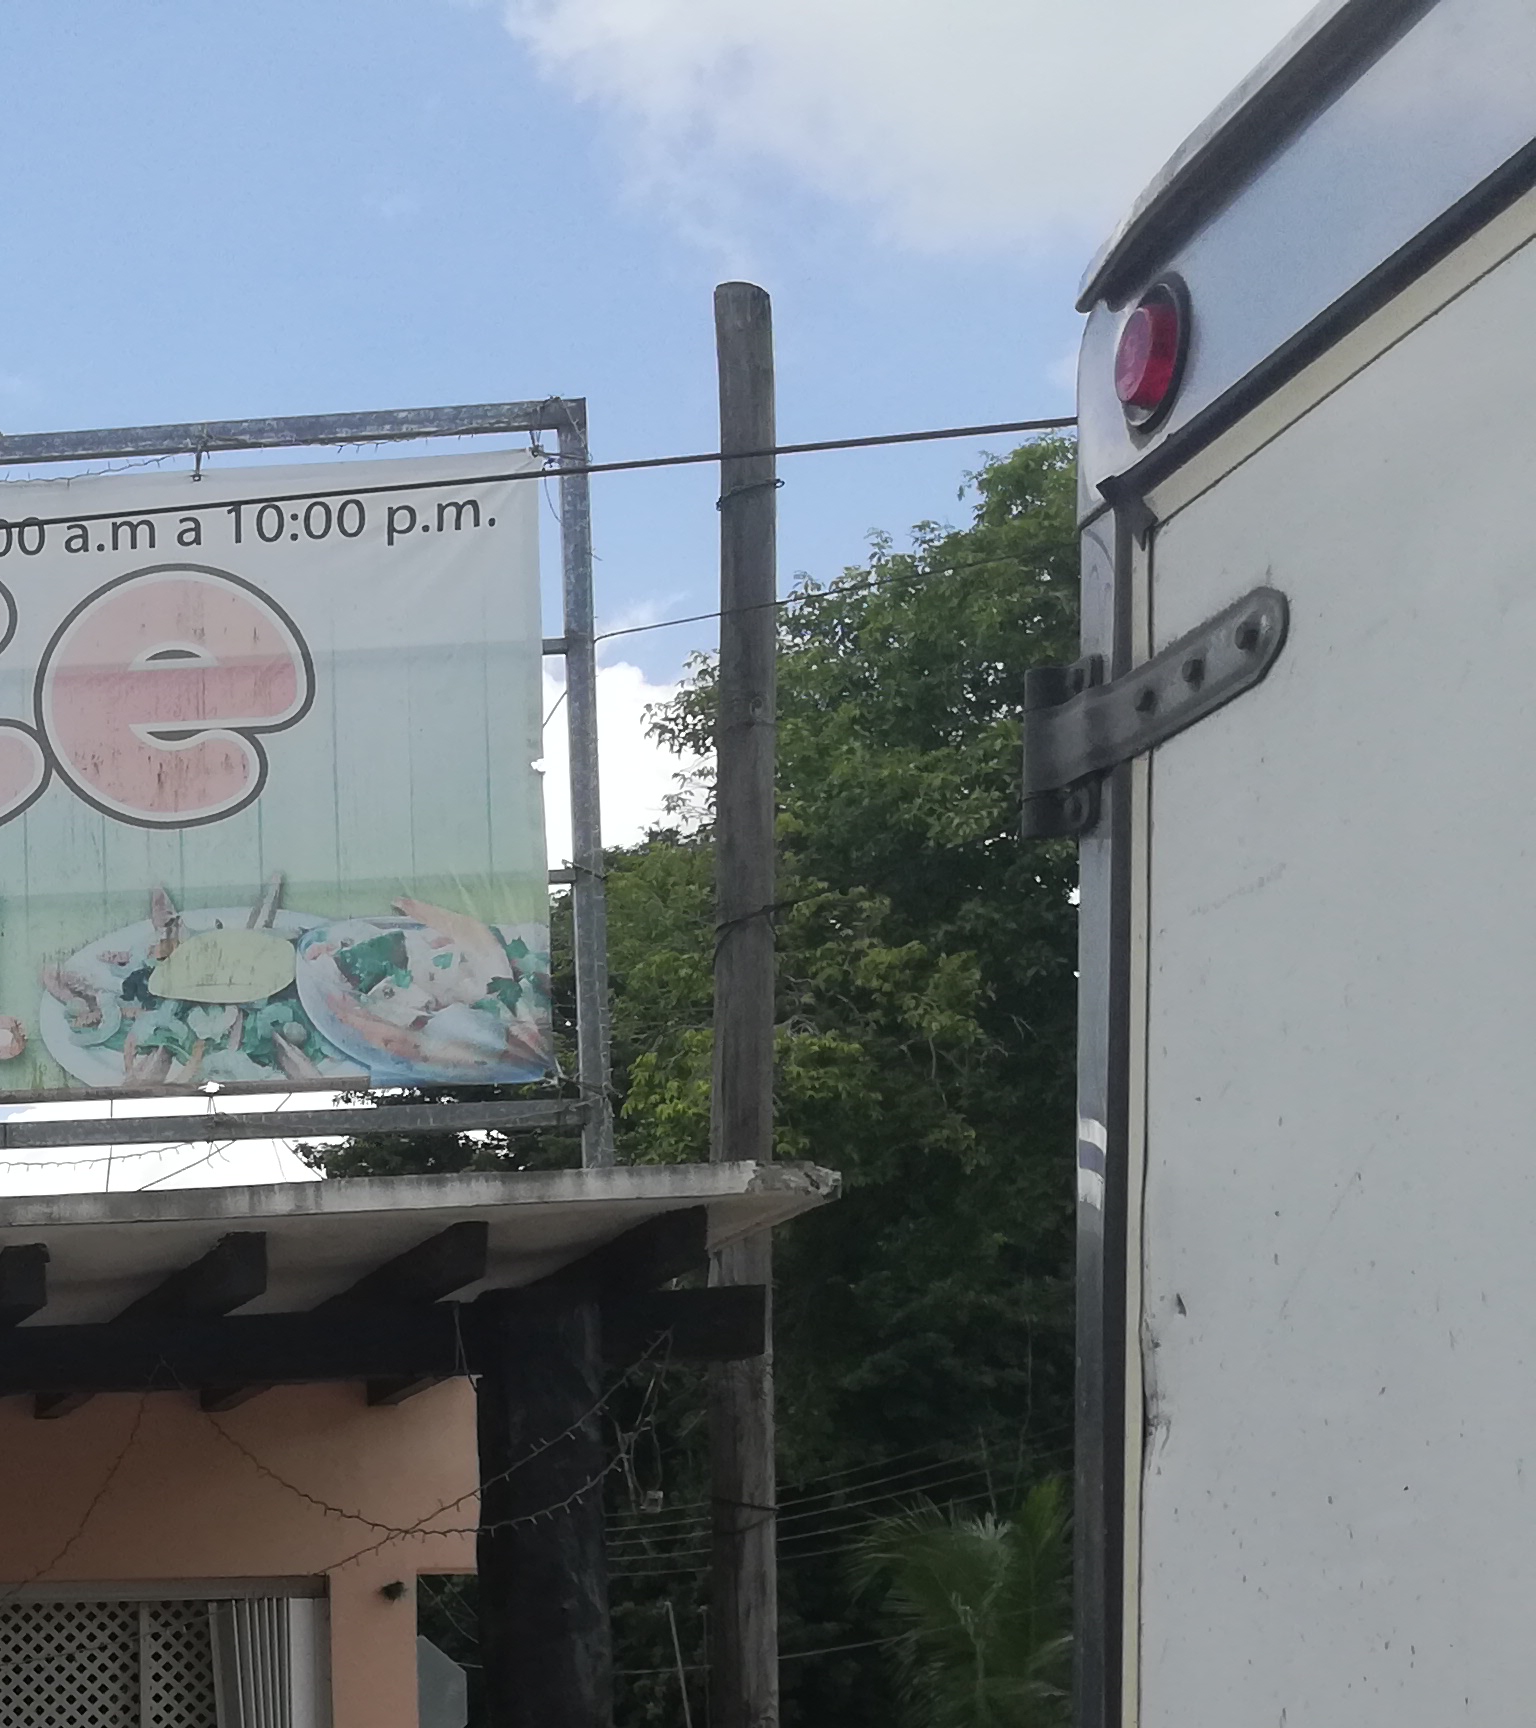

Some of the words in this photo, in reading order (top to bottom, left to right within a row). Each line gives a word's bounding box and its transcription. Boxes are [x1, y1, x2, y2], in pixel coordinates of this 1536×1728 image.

[64, 518, 156, 554] a.m
[176, 516, 202, 547] a
[227, 498, 366, 544] 10:00
[387, 498, 496, 546] p.m.
